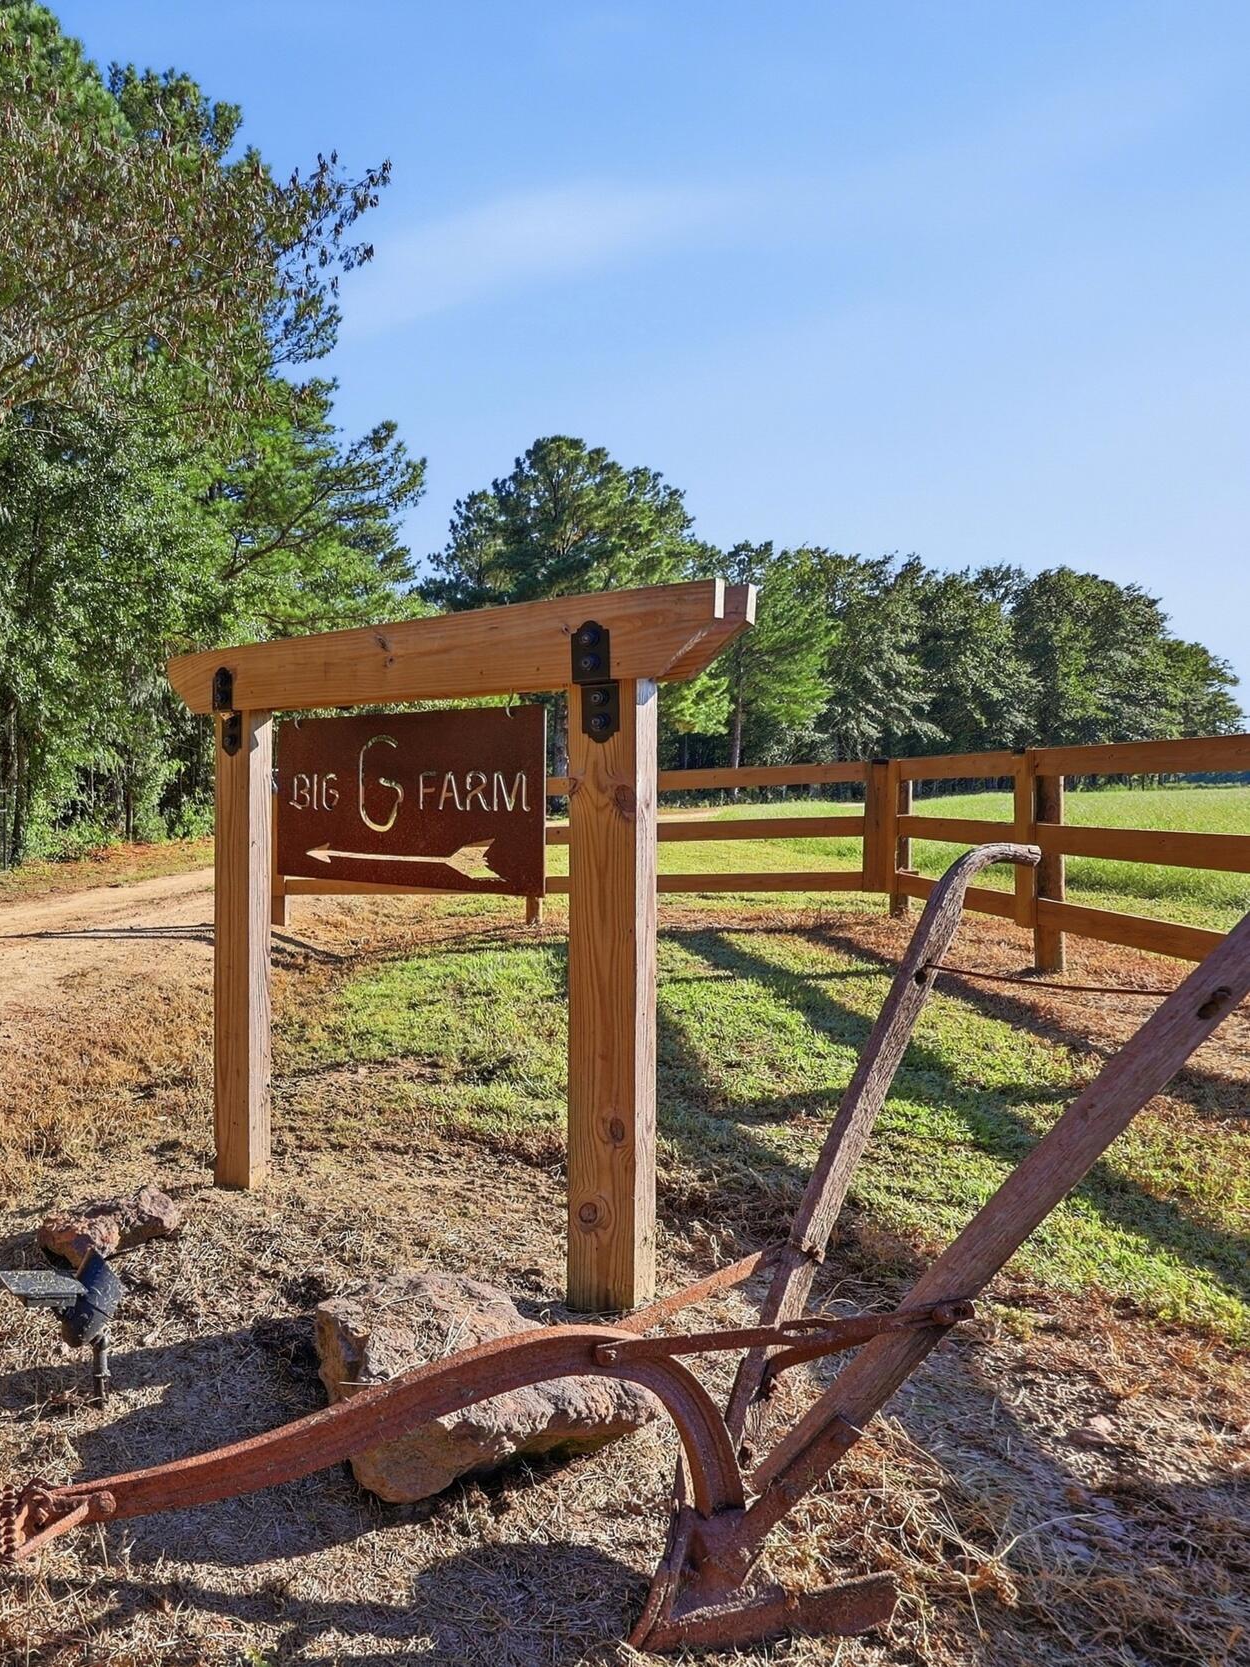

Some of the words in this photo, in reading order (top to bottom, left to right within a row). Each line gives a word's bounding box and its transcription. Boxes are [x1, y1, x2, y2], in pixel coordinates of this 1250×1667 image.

[289, 773, 339, 811] BIG
[359, 734, 405, 832] G
[419, 770, 531, 812] FARM
